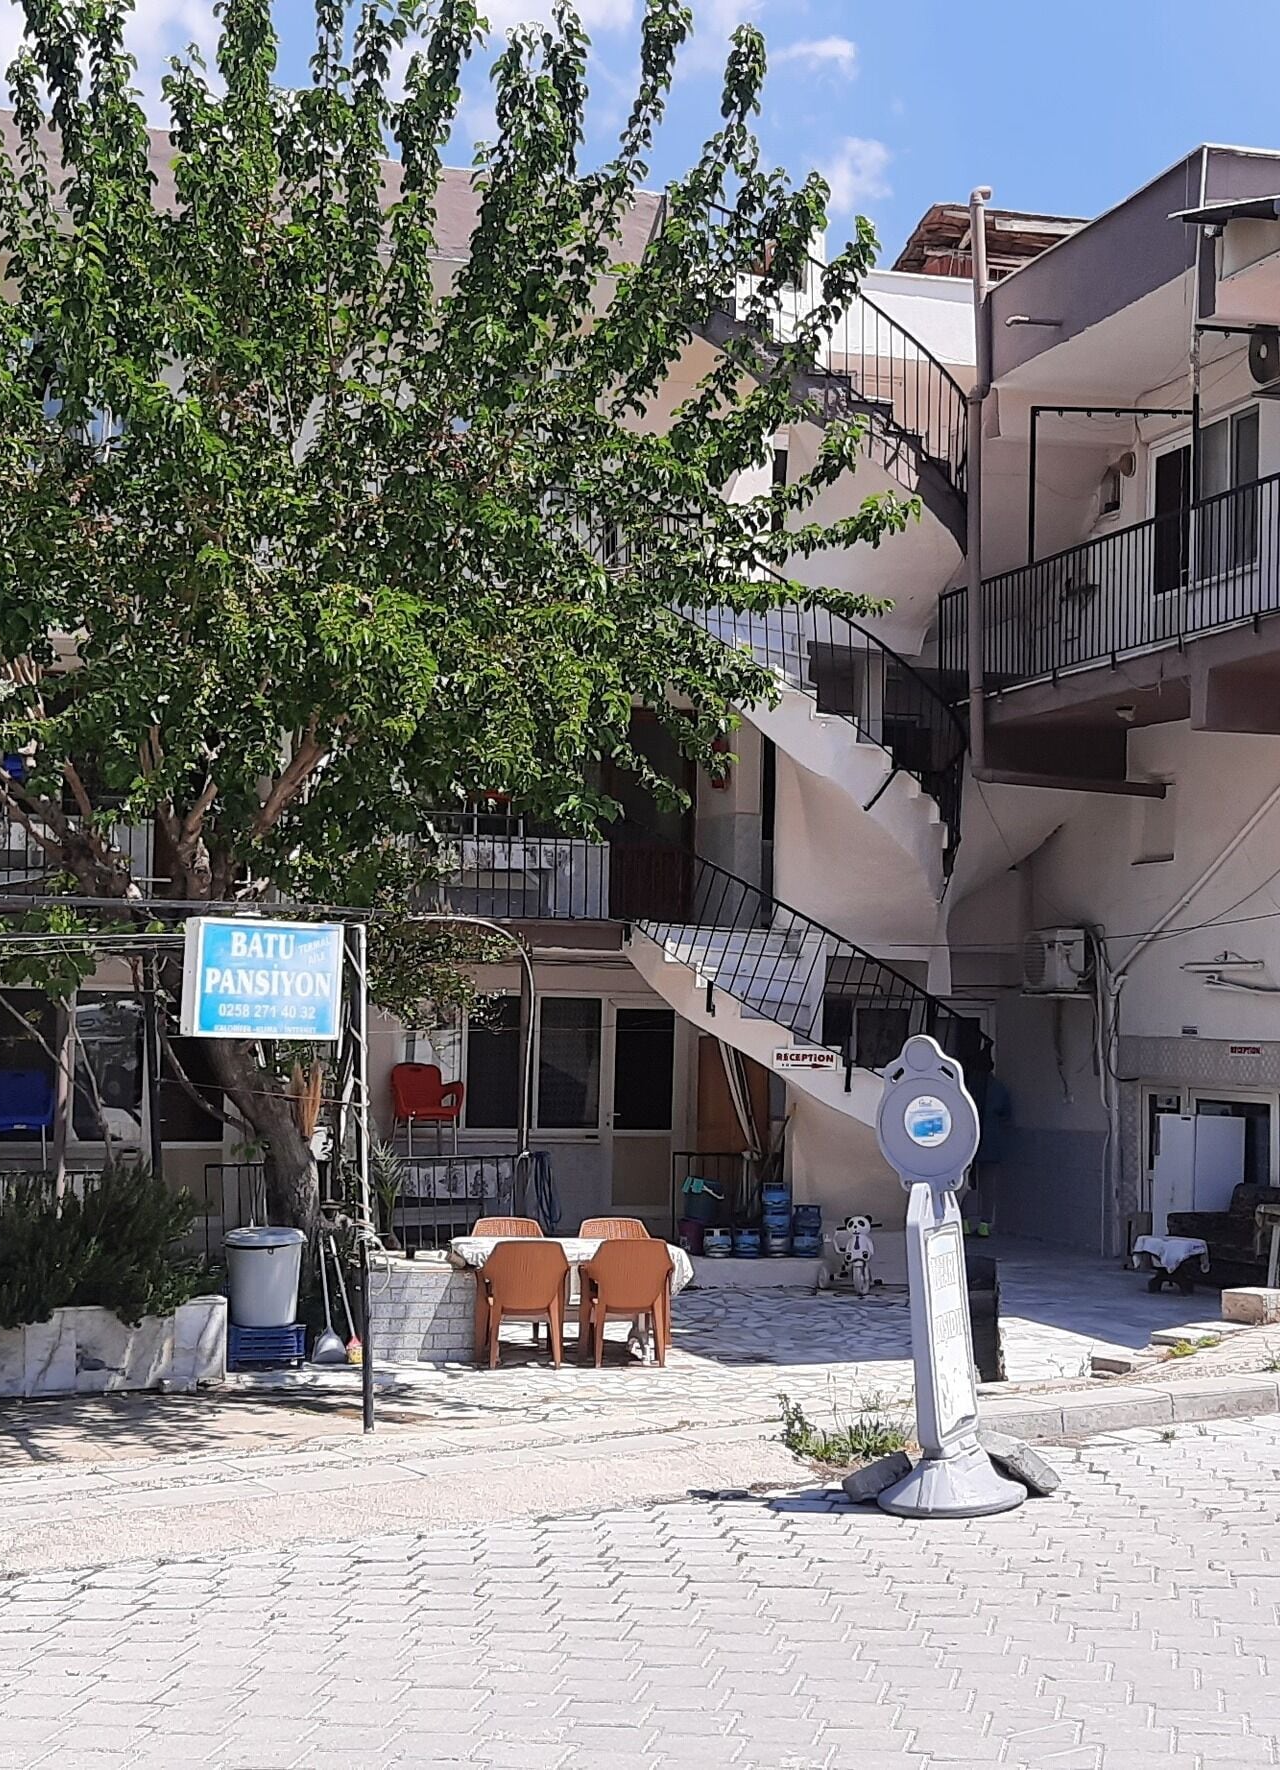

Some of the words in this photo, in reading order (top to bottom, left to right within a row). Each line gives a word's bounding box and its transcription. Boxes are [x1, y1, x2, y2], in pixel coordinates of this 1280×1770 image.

[230, 931, 296, 960] BATU
[204, 963, 333, 997] PANSİYON
[218, 1003, 250, 1018] 0258
[254, 1004, 277, 1019] 271
[281, 1005, 297, 1019] 40
[300, 1006, 317, 1020] 32
